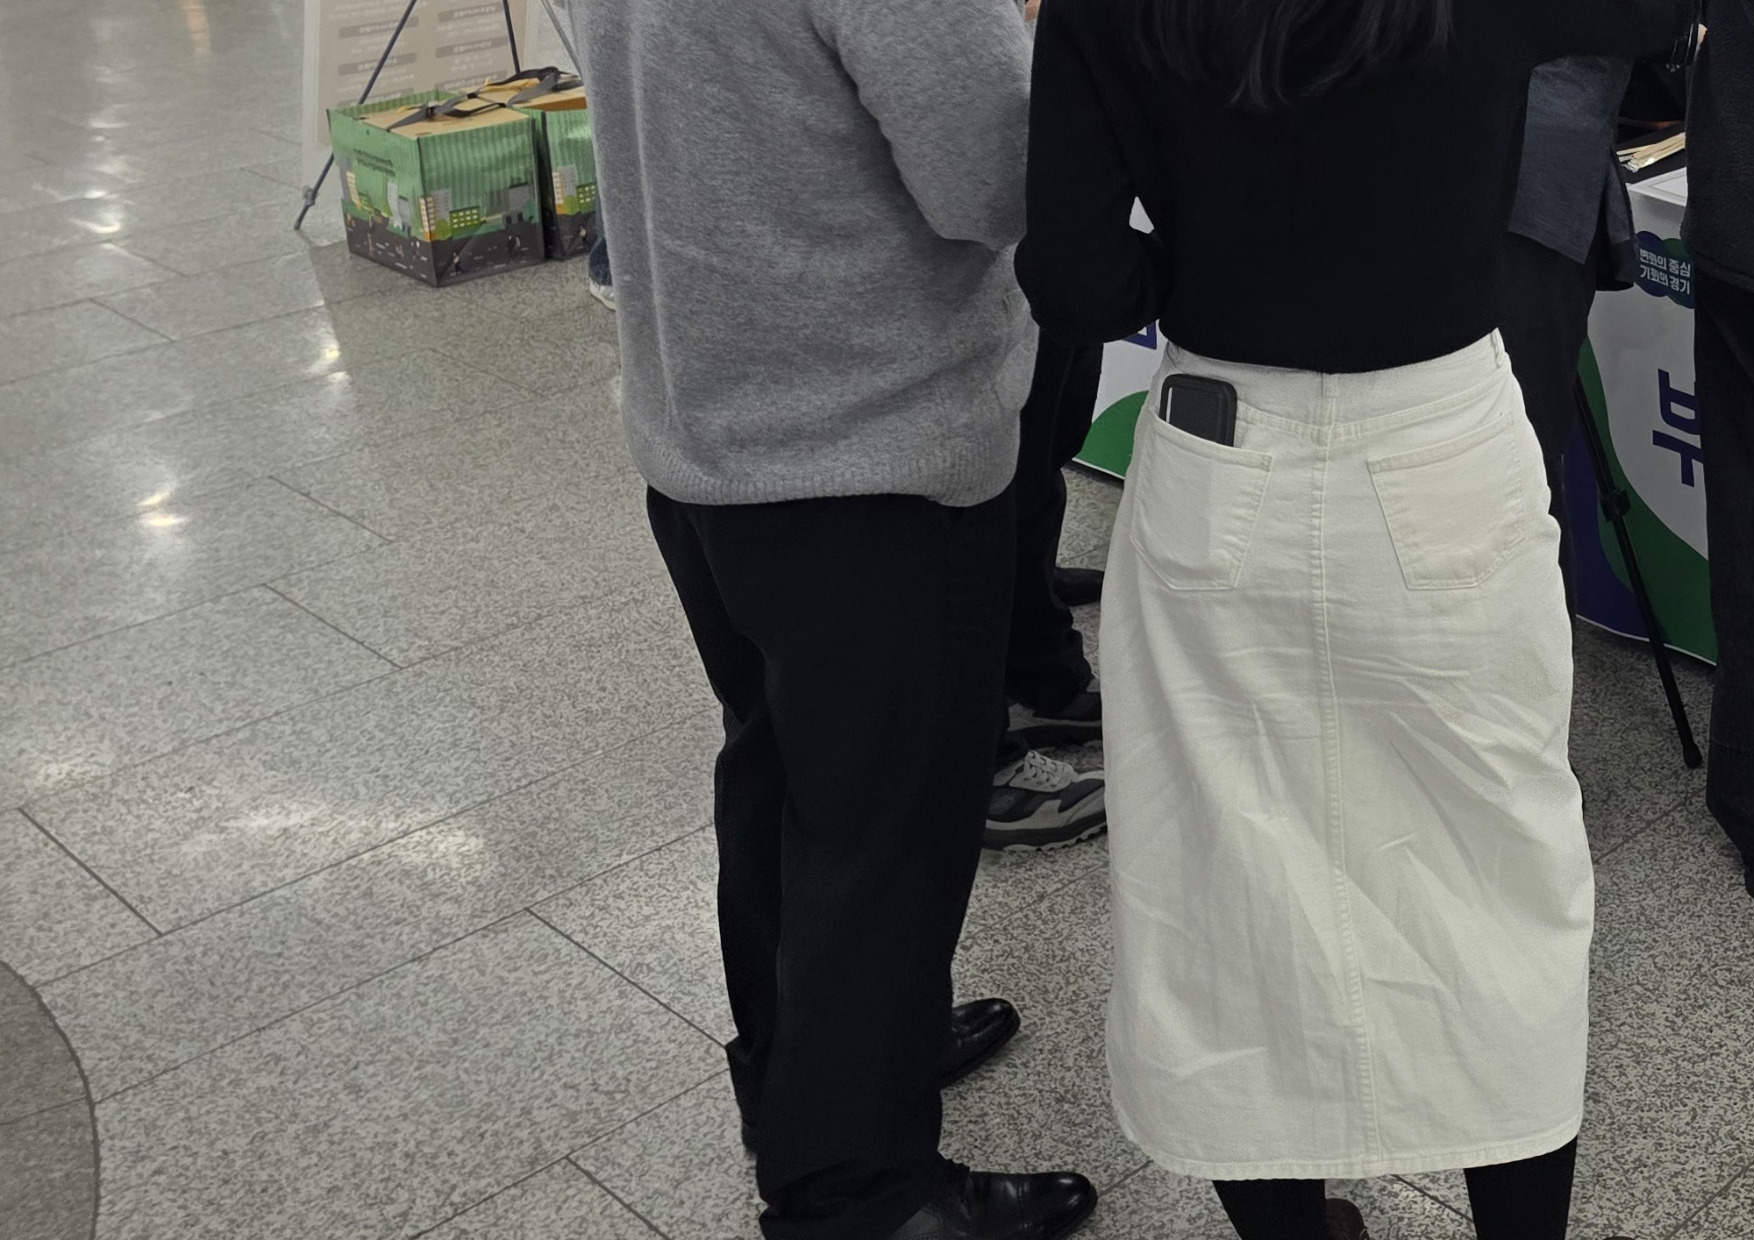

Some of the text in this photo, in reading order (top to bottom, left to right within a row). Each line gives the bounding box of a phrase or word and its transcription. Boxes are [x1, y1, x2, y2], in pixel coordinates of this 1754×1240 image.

[1640, 248, 1690, 278] 변화의 중심
[1640, 265, 1690, 294] 기회의 경기
